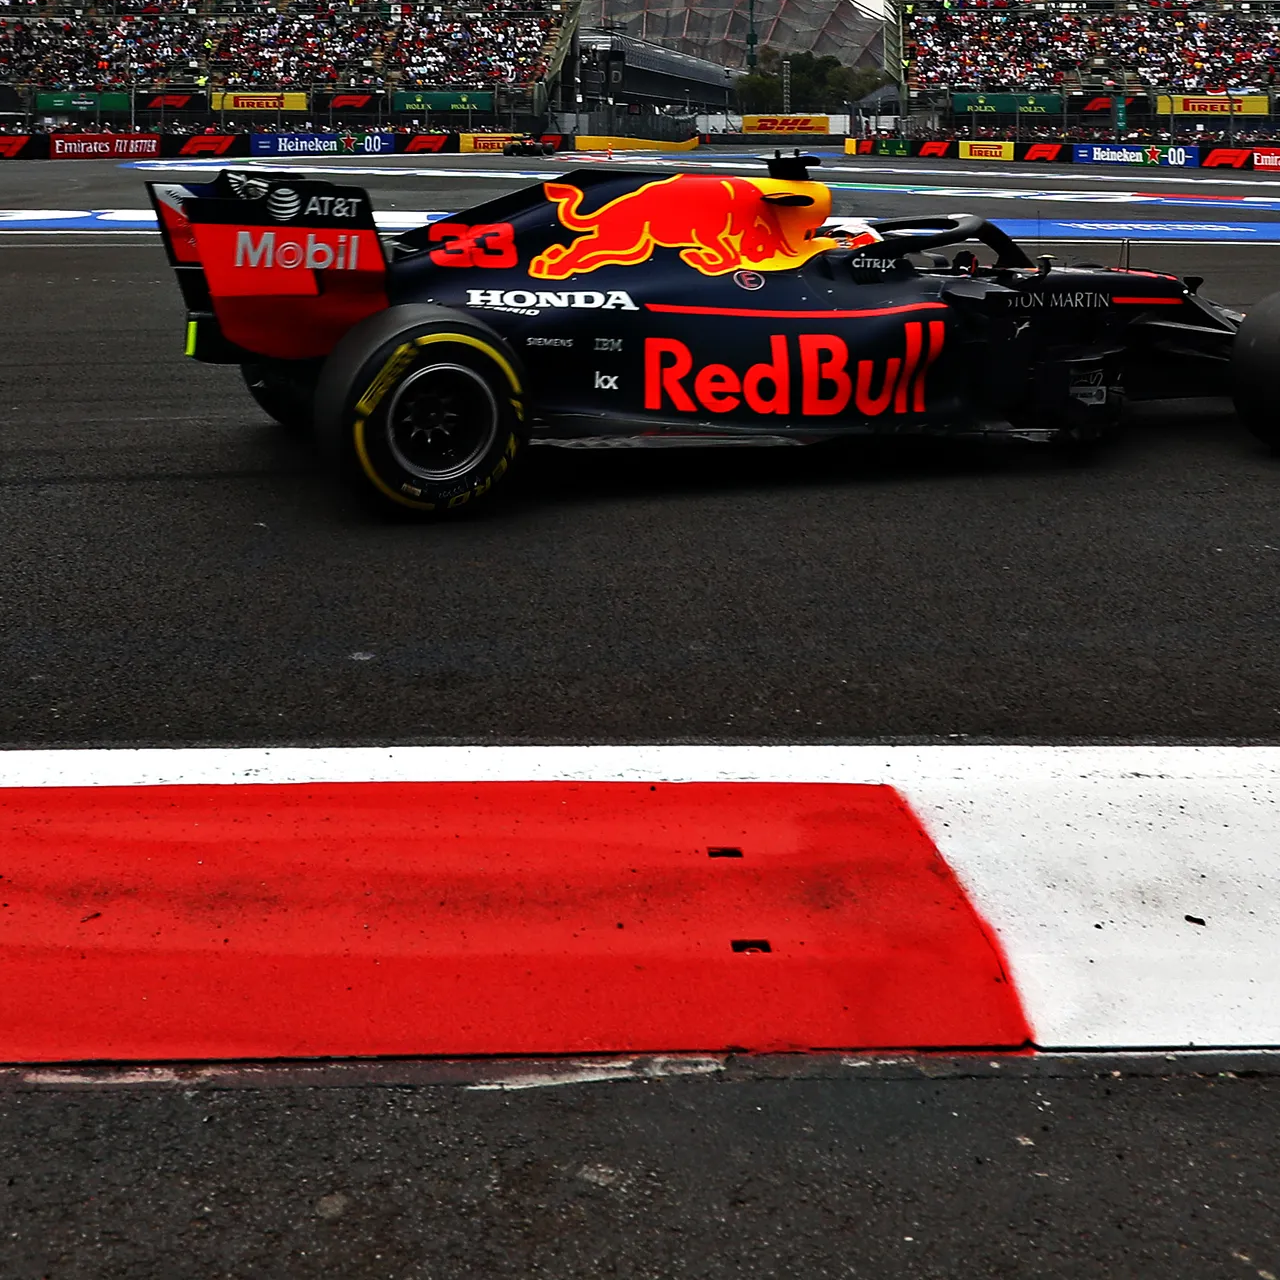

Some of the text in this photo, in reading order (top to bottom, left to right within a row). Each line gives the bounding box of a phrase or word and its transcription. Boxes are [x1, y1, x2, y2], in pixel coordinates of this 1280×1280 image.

[233, 95, 285, 109] PIRELLI
[1183, 98, 1243, 112] PIRELLI
[757, 118, 815, 131] DHL
[55, 139, 157, 154] Emirates FLY BETTER
[277, 137, 338, 152] Heineken
[969, 143, 1003, 158] PIRELLI
[1092, 147, 1143, 163] Heineken
[304, 195, 363, 218] AT&T
[234, 230, 360, 270] Mobil
[428, 222, 519, 269] 33
[465, 289, 641, 312] HONDA
[1050, 292, 1110, 308] MARTIN
[525, 336, 574, 348] SIEMENS
[593, 337, 623, 352] IBM
